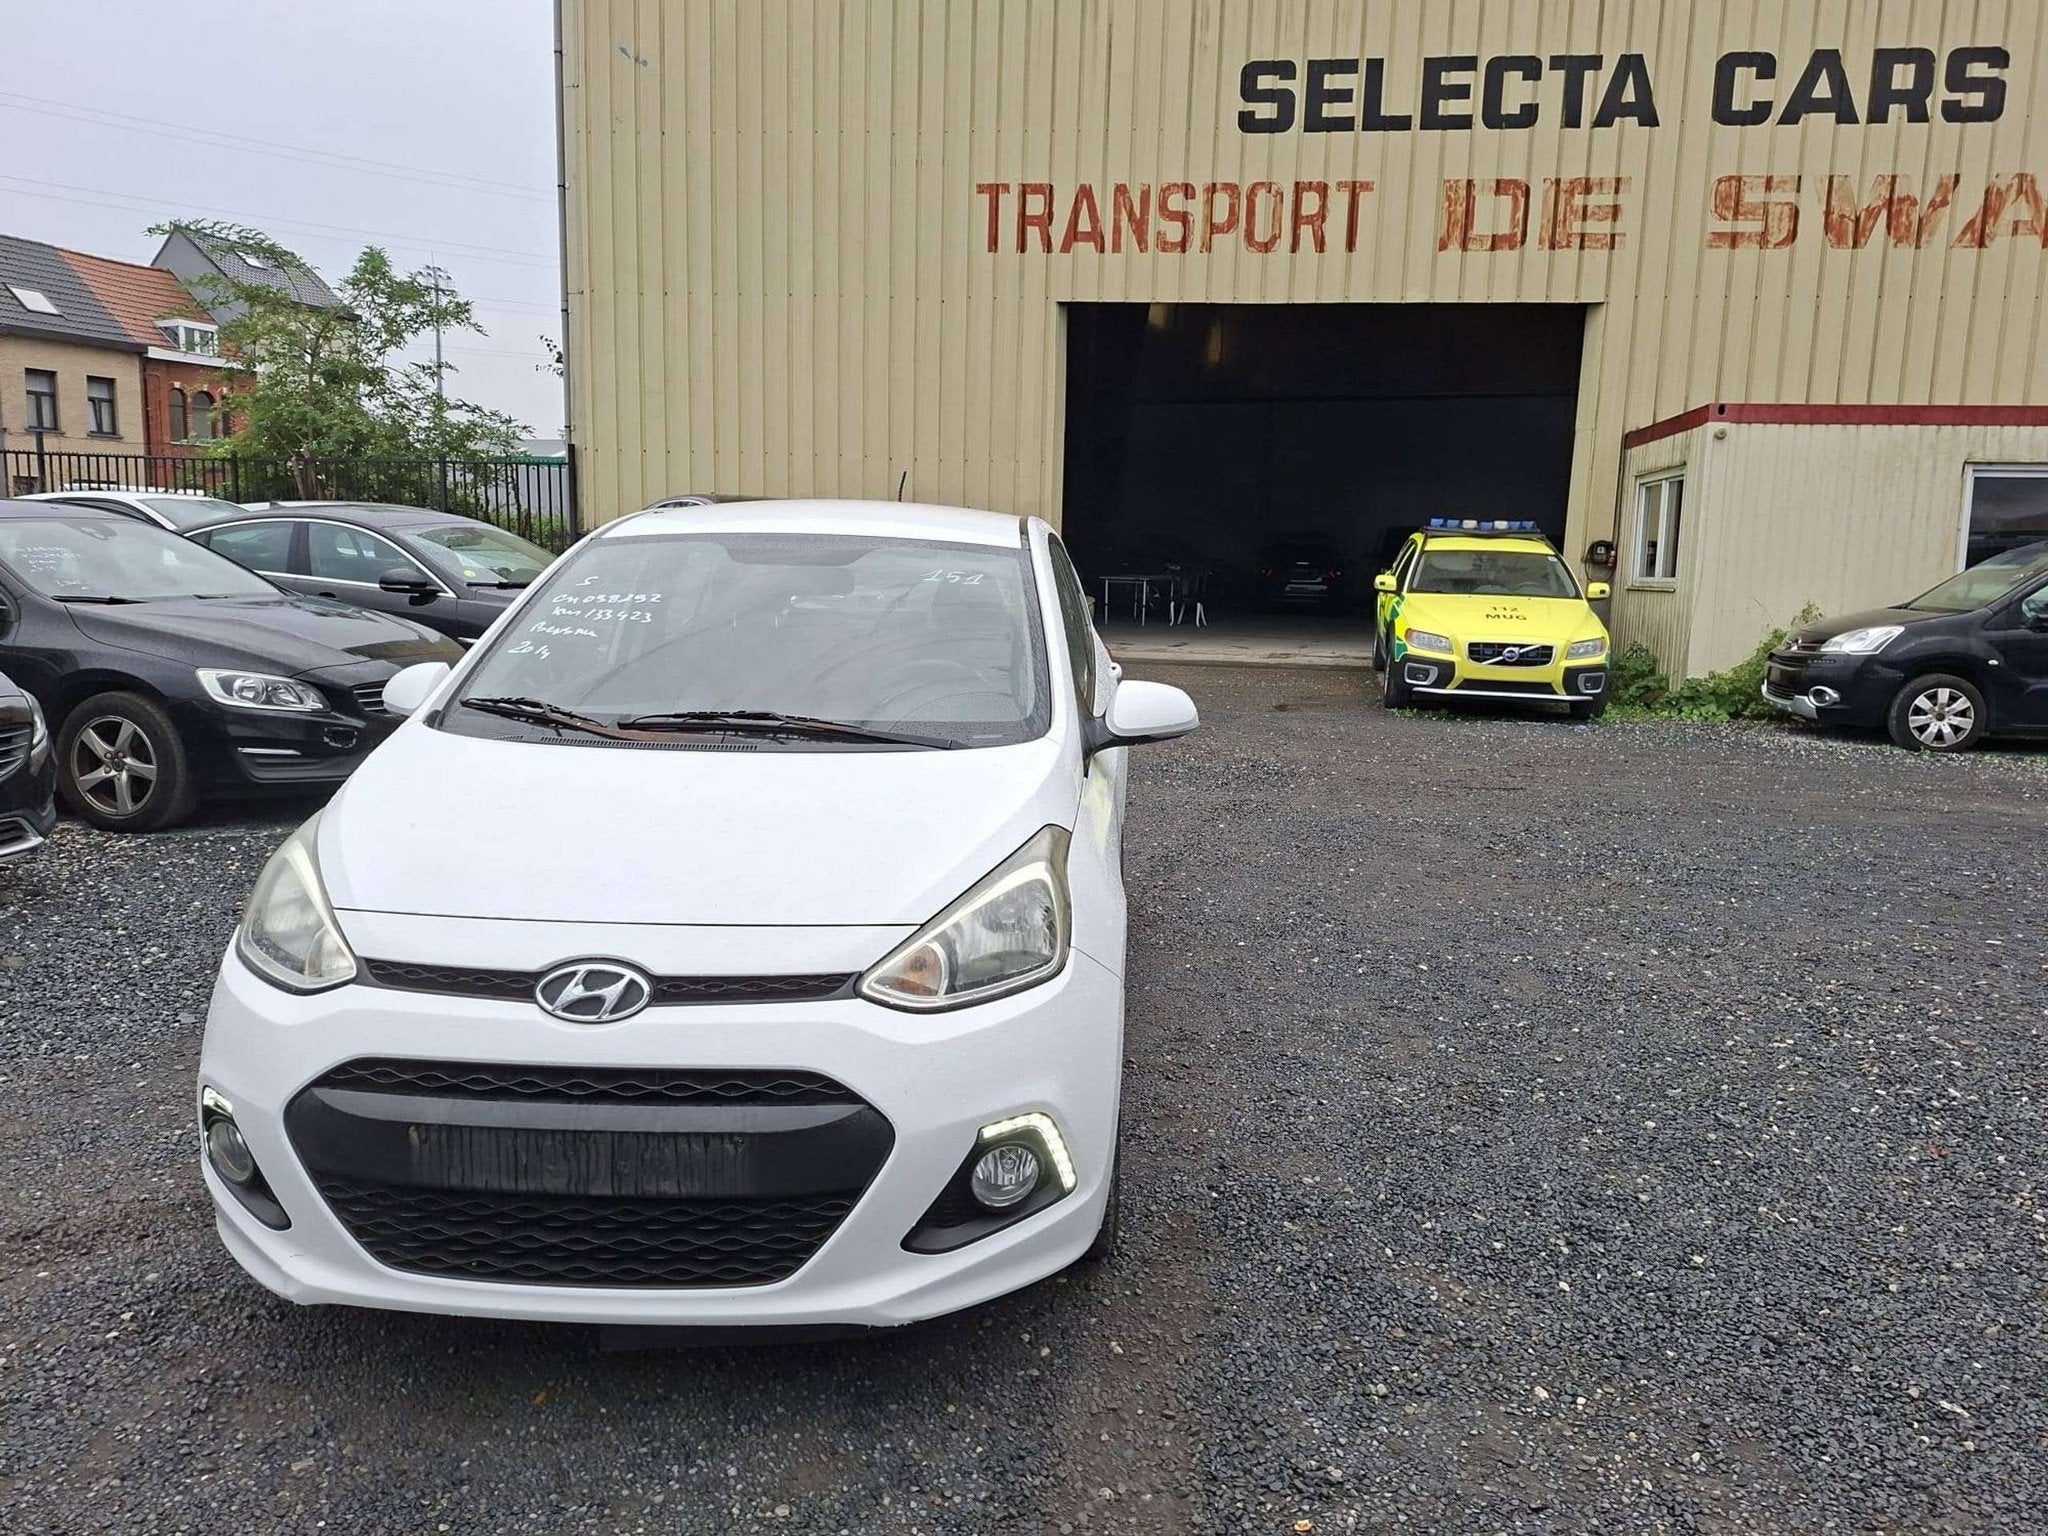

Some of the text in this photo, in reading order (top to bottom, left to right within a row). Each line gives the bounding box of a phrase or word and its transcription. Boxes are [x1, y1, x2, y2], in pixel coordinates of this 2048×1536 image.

[1238, 46, 2010, 134] SELECTA CARS
[976, 180, 1375, 255] TRANSPORT
[1439, 175, 1633, 253] DE
[1485, 613, 1527, 621] MUG
